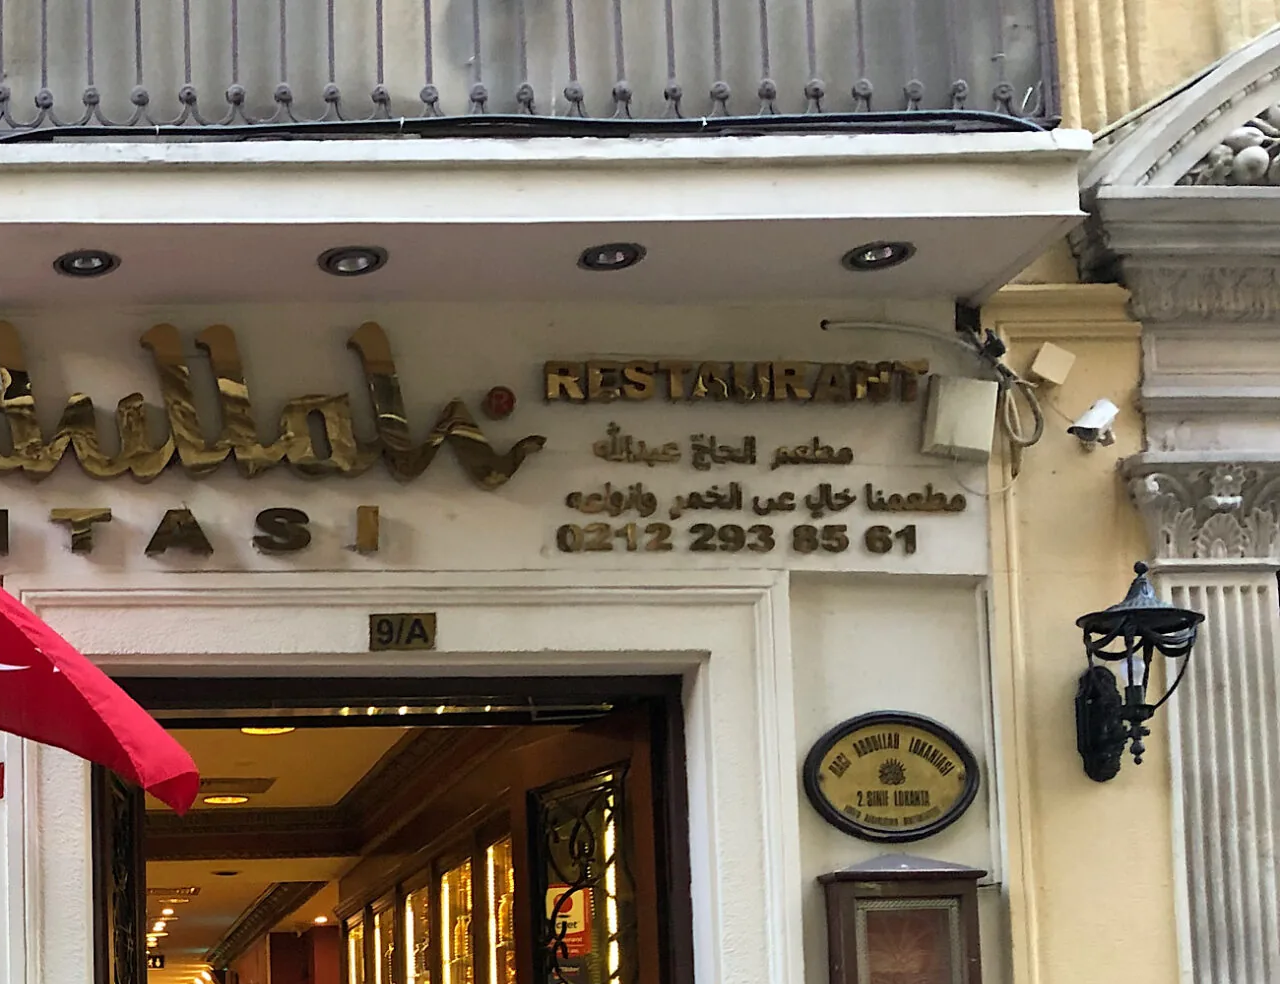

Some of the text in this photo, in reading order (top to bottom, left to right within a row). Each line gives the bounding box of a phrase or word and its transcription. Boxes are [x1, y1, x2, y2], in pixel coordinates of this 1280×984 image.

[543, 359, 929, 402] RESTAURANT
[770, 436, 854, 471] مطعم
[669, 481, 743, 520] الخمر
[864, 482, 967, 513] مطعمنا
[556, 523, 918, 554] 0212 293 85 61
[376, 618, 429, 646] 9/A
